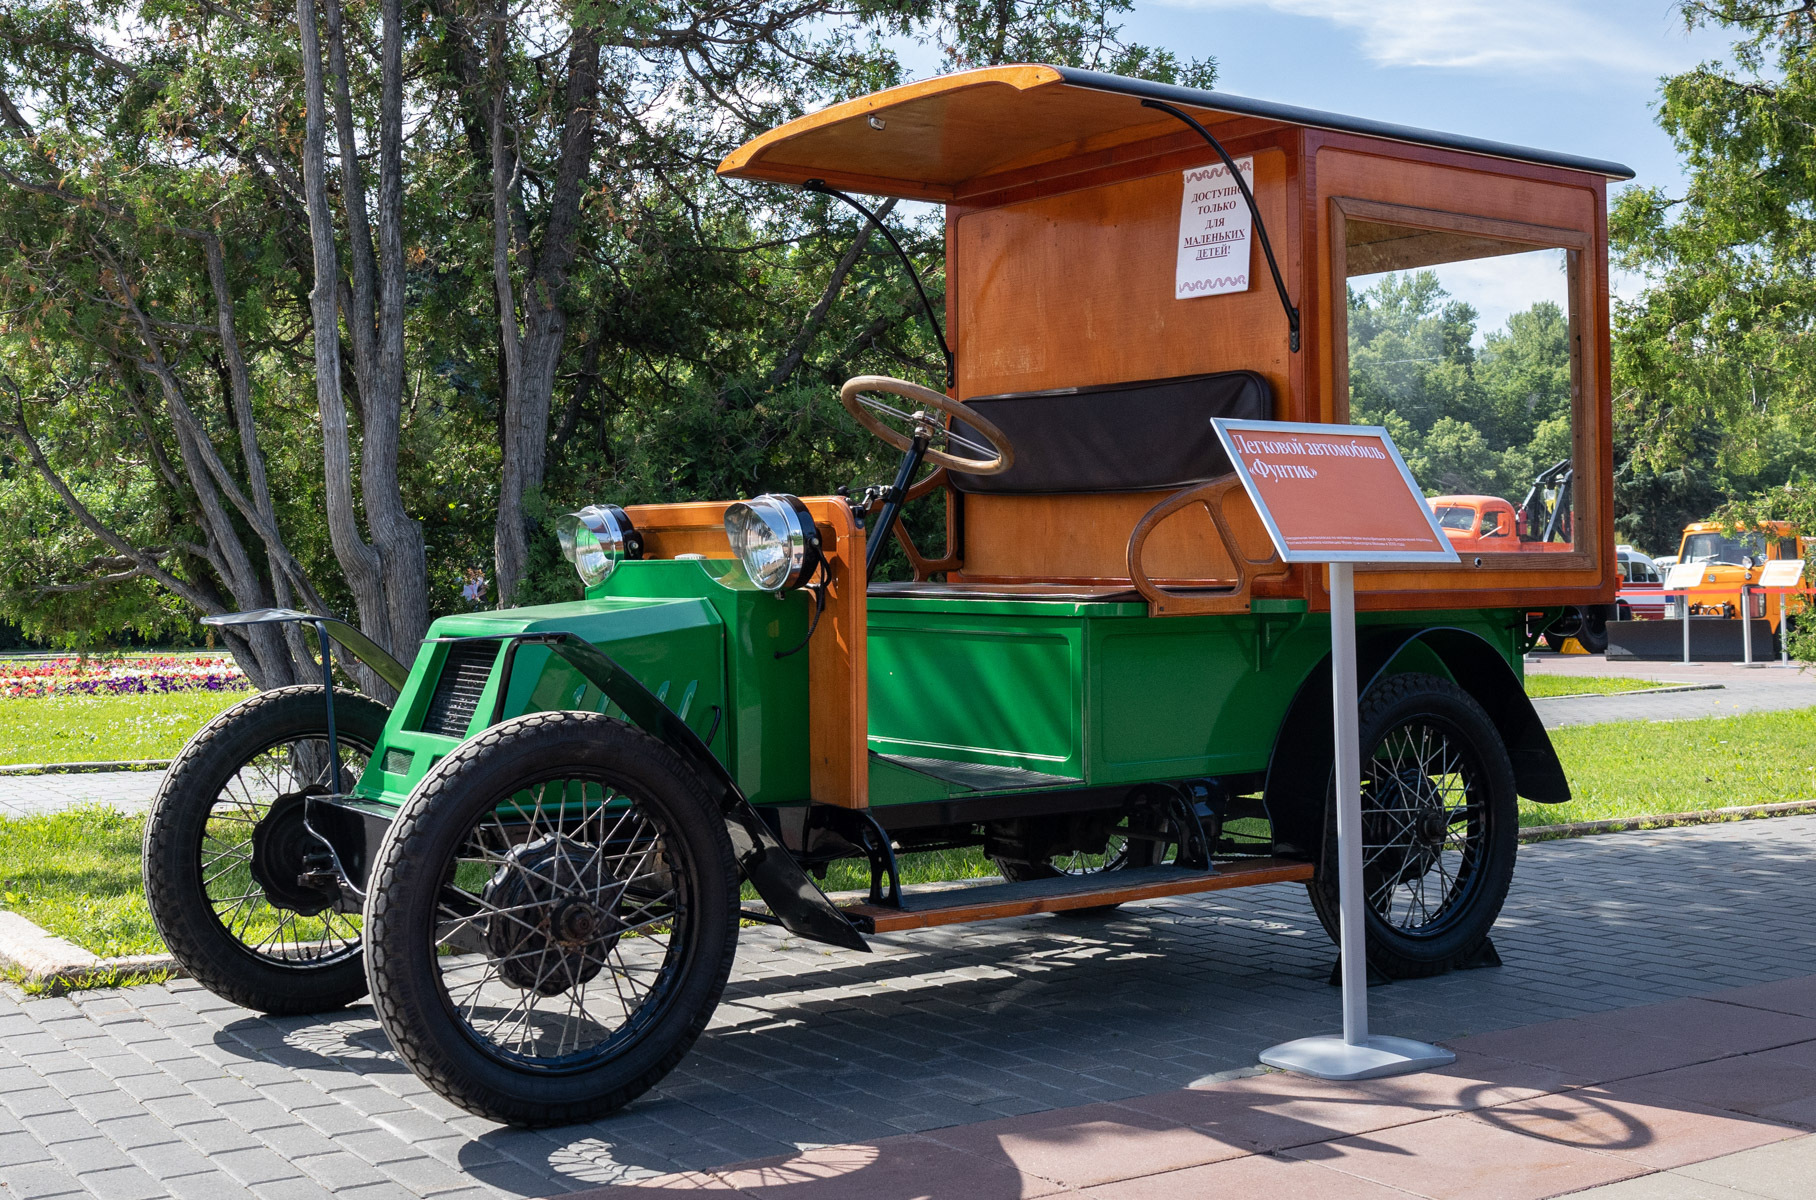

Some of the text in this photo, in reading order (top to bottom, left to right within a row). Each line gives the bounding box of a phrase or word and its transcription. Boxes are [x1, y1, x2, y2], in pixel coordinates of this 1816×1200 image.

[1198, 200, 1236, 215] ТОЛЬКО
[1204, 217, 1225, 230] ДЛЯ
[1184, 228, 1245, 248] МАЛЕНЬКИХ
[1196, 243, 1231, 260] ДЕТЕЙ!
[1232, 434, 1386, 460] Легковой автомобиль
[1249, 458, 1318, 483] «Фунтик»
